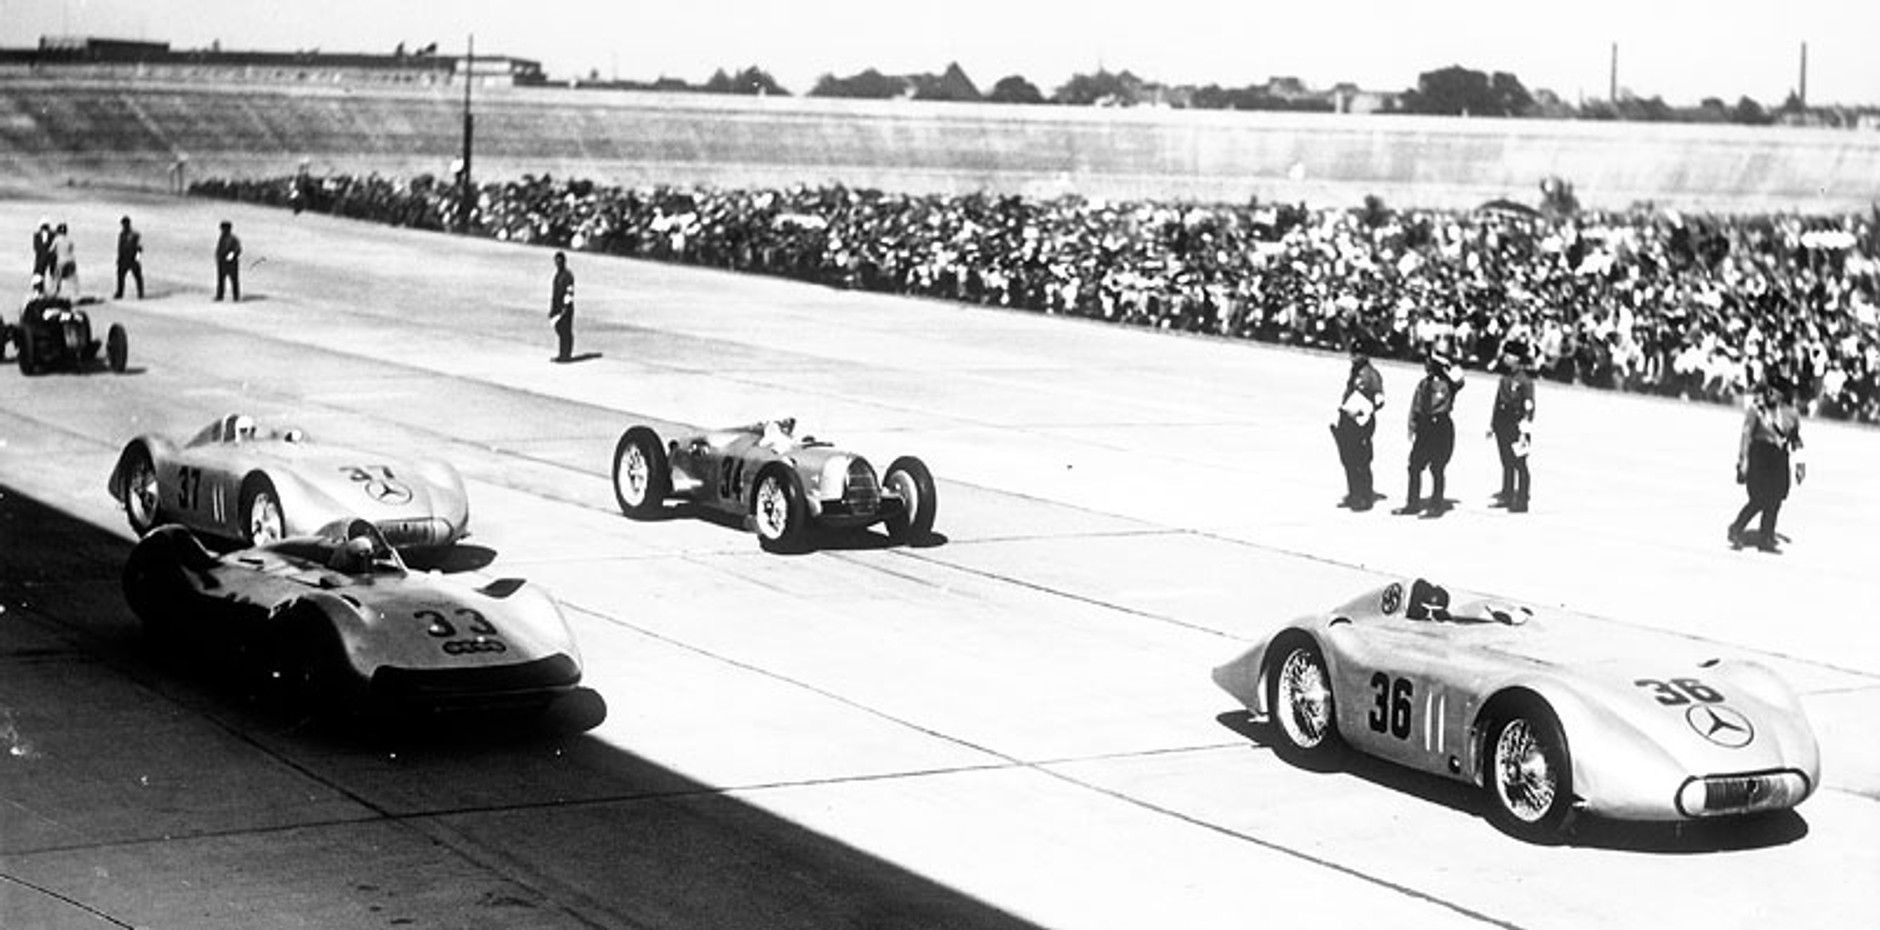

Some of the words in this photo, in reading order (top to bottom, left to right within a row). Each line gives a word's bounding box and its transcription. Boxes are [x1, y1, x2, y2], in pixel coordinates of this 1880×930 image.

[178, 465, 200, 511] 37
[338, 465, 396, 481] 37
[720, 456, 745, 499] 34
[413, 608, 497, 637] 33
[1369, 671, 1413, 741] 36
[1634, 678, 1725, 706] 36
